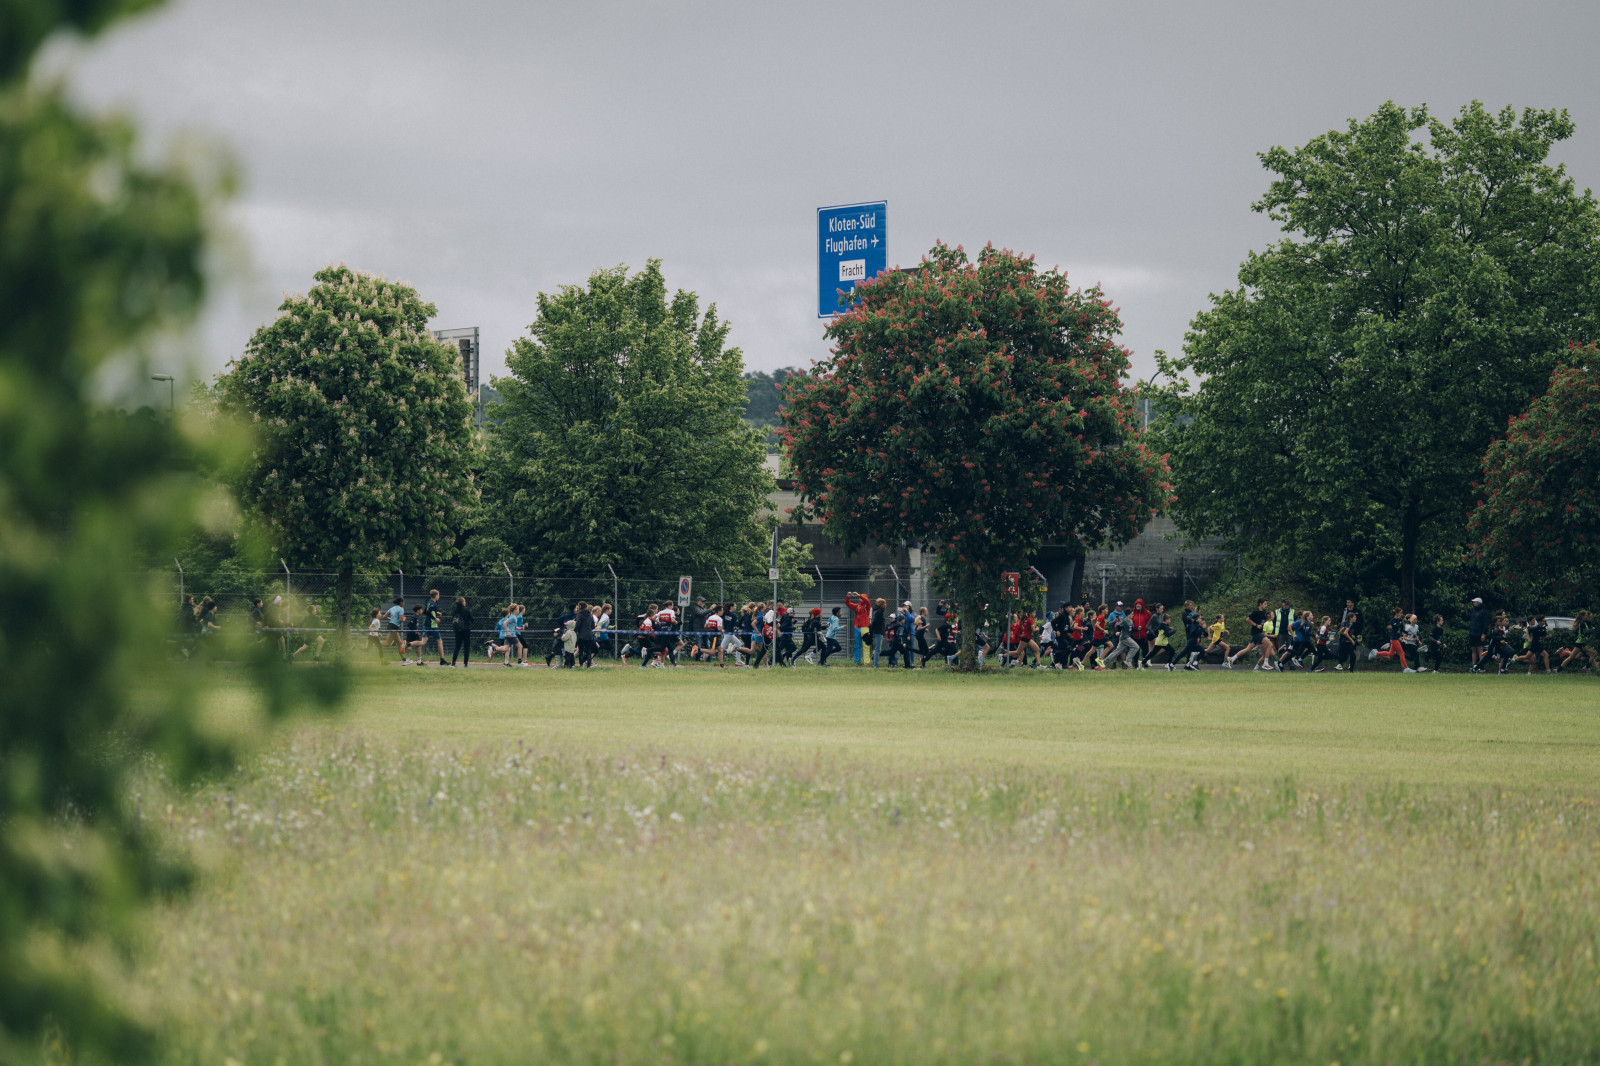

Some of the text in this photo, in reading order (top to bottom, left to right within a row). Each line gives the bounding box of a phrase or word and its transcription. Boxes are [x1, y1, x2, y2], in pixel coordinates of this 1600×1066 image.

[829, 212, 876, 233] Kloten-Süd
[825, 234, 868, 256] Flughafen
[841, 263, 863, 277] Fracht
